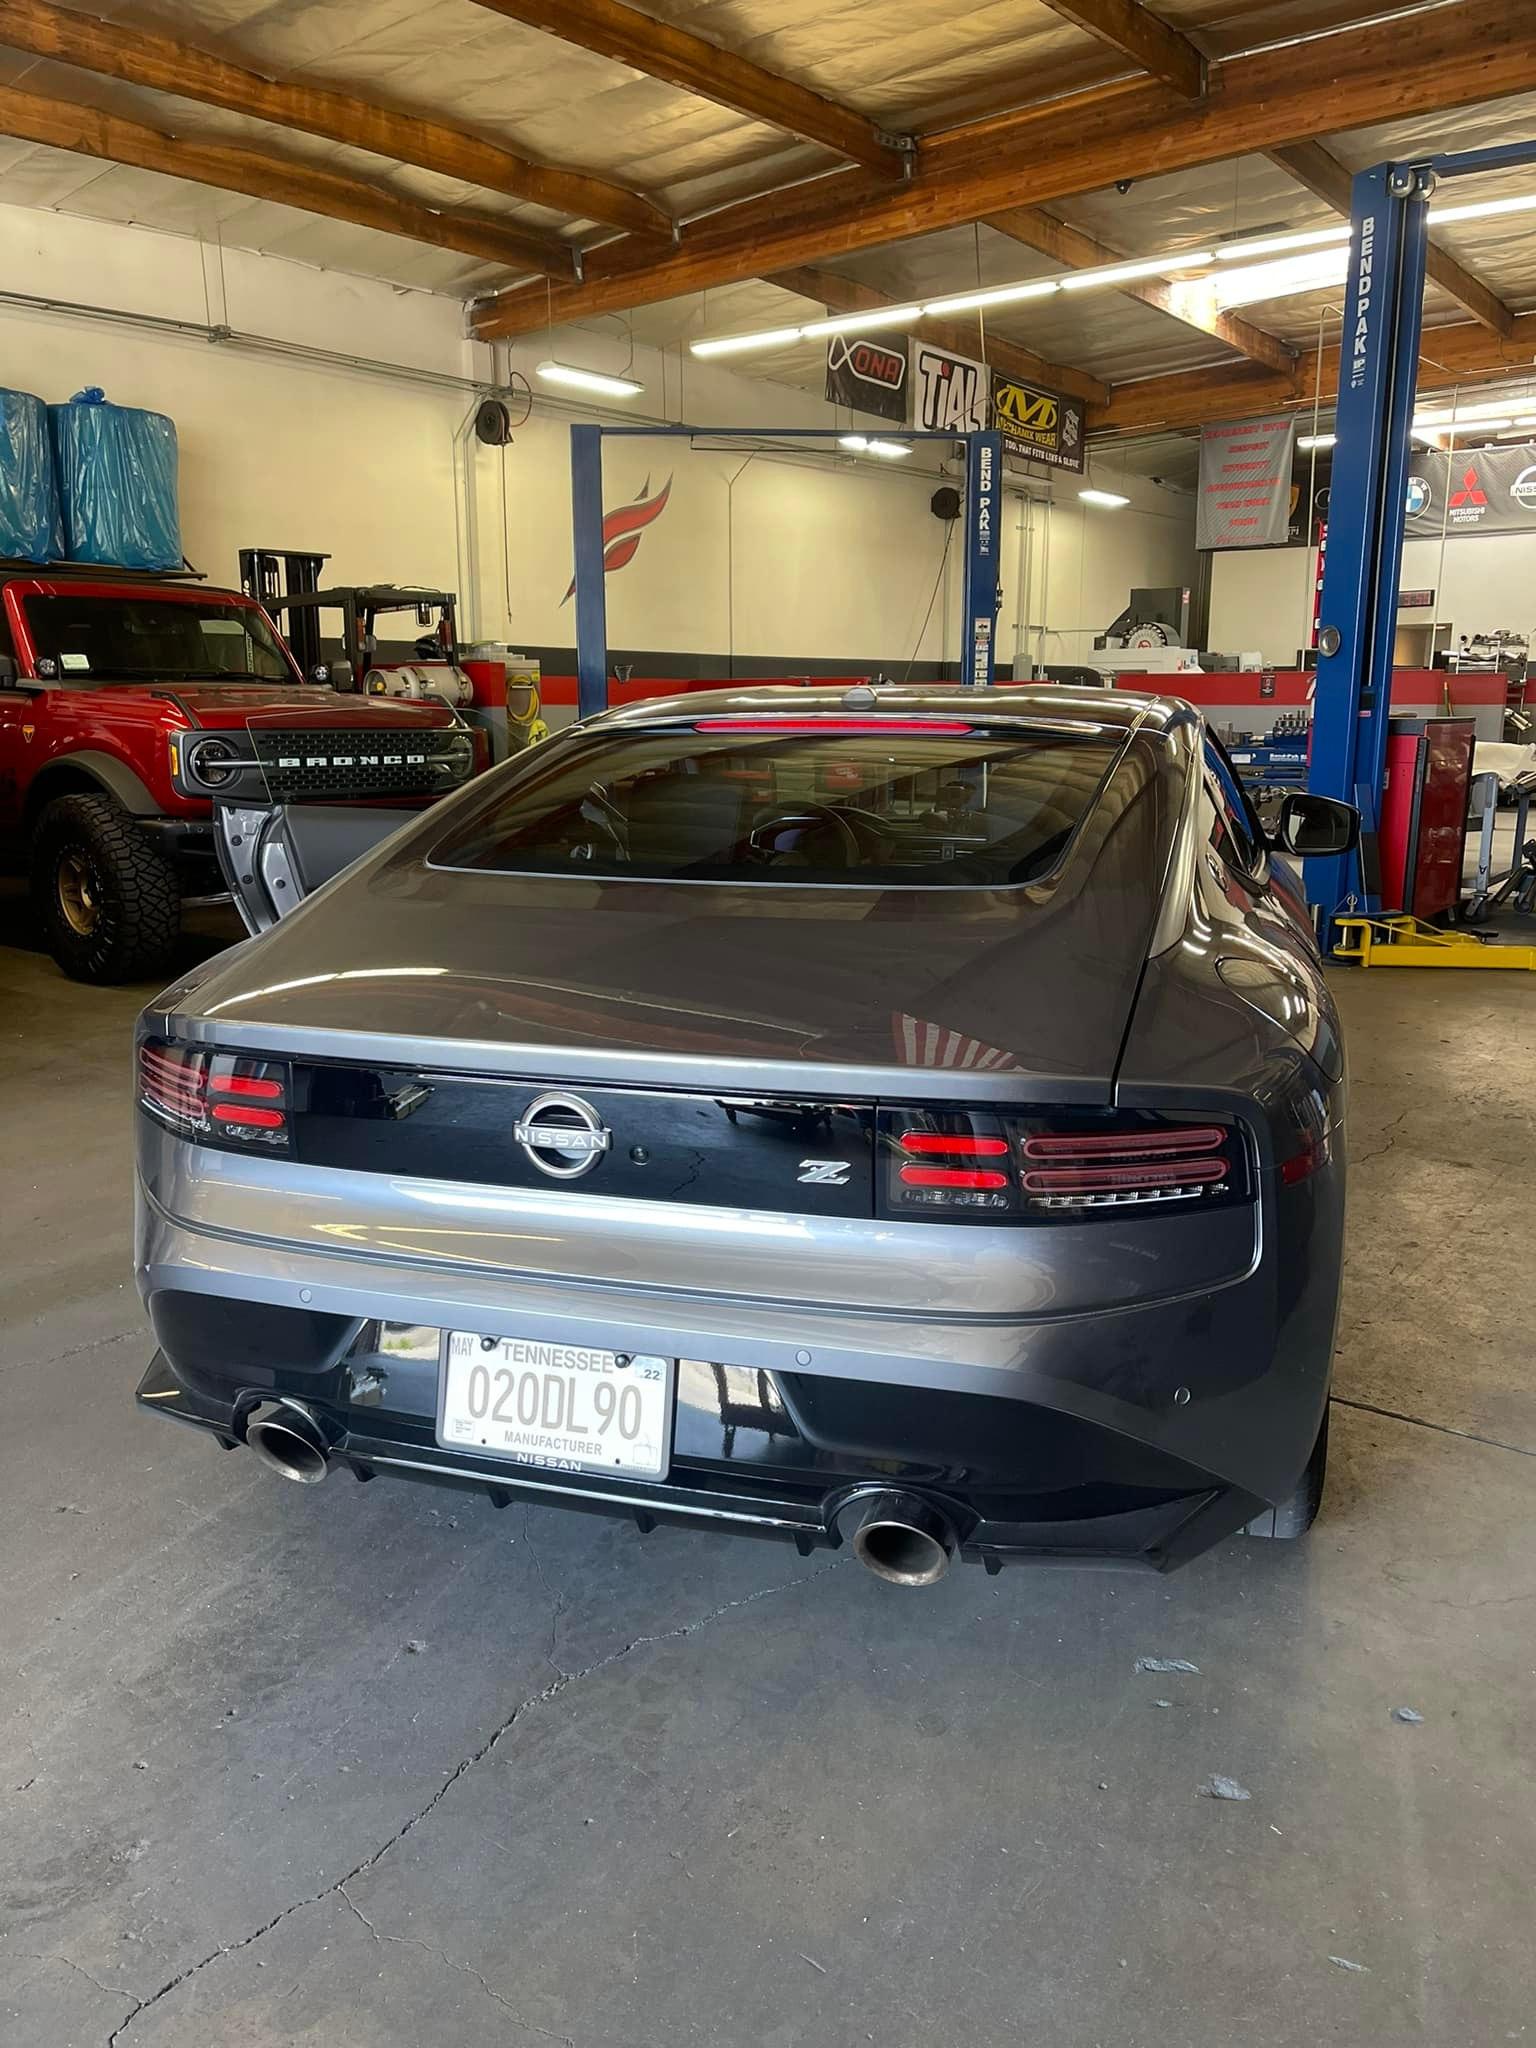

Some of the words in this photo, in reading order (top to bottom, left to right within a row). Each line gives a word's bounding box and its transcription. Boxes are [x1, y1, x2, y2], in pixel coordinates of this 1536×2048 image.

[996, 416, 1034, 440] MECHANIX
[1034, 432, 1056, 447] WEAR
[1449, 507, 1485, 518] MITSUBISHI
[1453, 515, 1480, 523] MOTORS
[279, 755, 425, 767] BRONCO
[515, 1127, 608, 1150] NISSAN
[797, 1159, 851, 1186] Z
[451, 1336, 474, 1356] MAY
[502, 1342, 614, 1374] TENNESSEE
[644, 1369, 661, 1381] 22
[504, 1430, 602, 1456] MANUFACTURER
[516, 1452, 582, 1472] NISSAN
